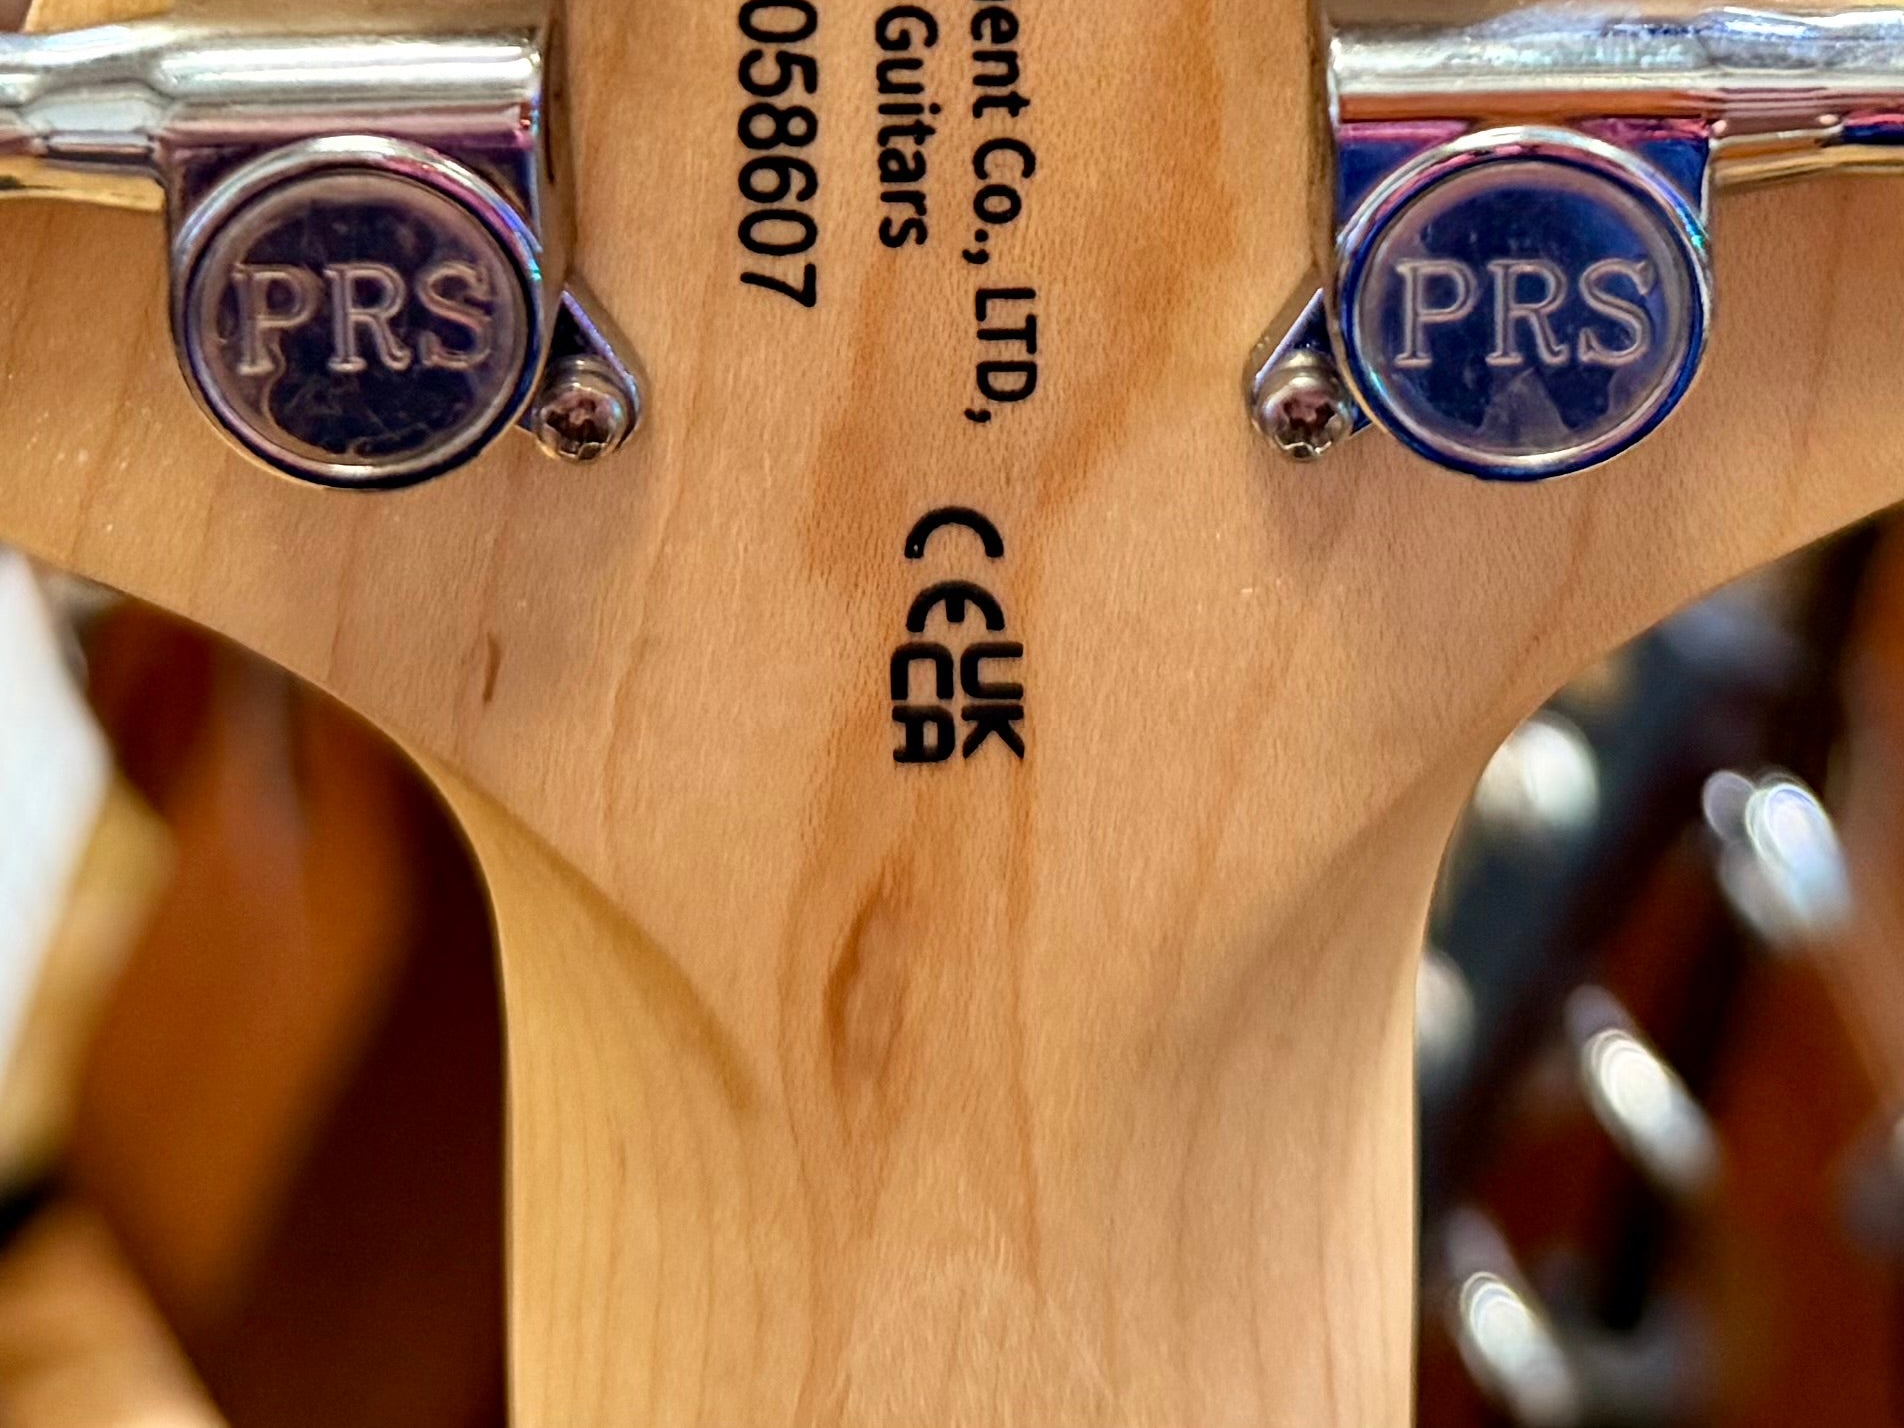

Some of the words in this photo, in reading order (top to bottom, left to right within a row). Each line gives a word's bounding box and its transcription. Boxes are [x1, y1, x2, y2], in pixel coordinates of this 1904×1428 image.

[874, 4, 943, 249] Guitars
[961, 136, 1037, 266] Co.,
[231, 260, 494, 377] PRS
[963, 286, 1038, 425] LTD,
[1395, 256, 1655, 369] PRS
